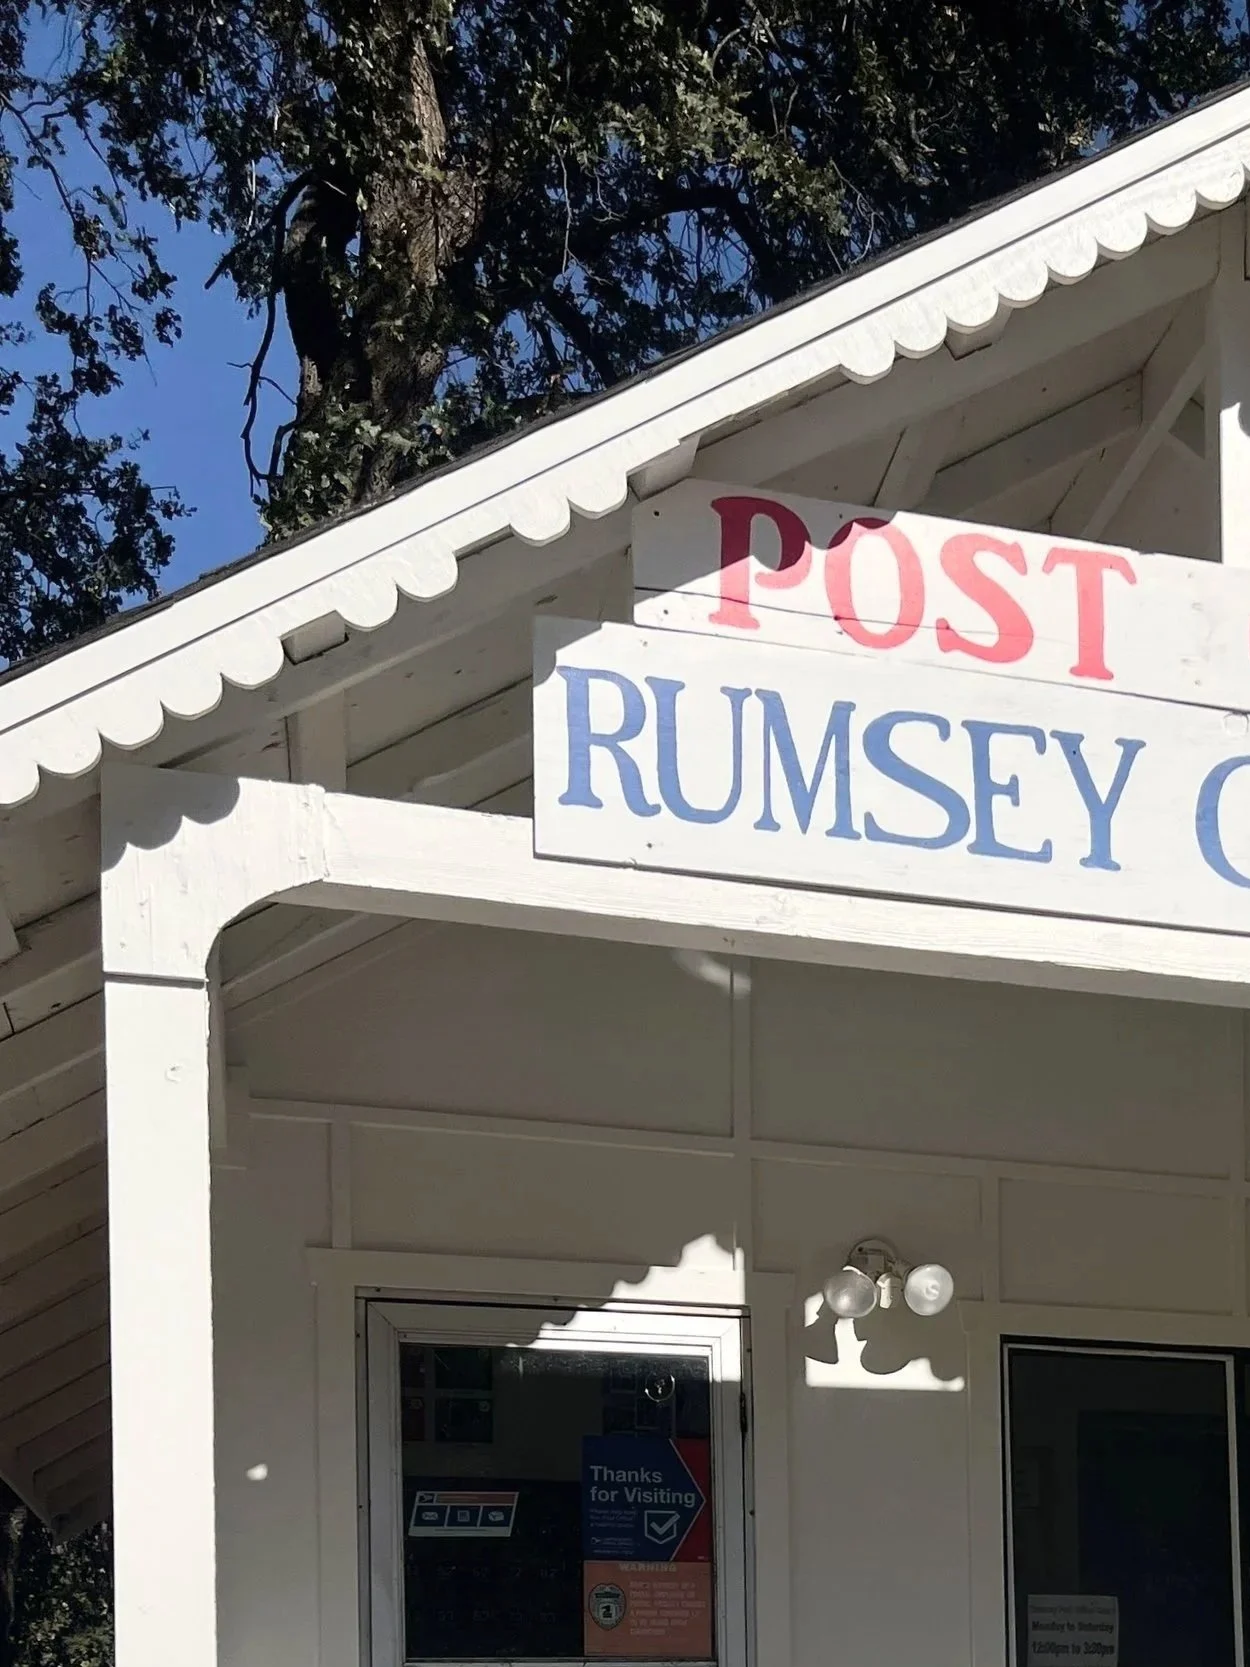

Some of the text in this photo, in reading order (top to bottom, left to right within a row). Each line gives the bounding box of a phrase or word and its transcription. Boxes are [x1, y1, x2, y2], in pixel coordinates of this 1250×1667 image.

[710, 495, 1137, 681] POST
[556, 666, 1146, 871] RUMSEY
[589, 1465, 663, 1484] Thanks
[590, 1486, 696, 1508] for Visiting
